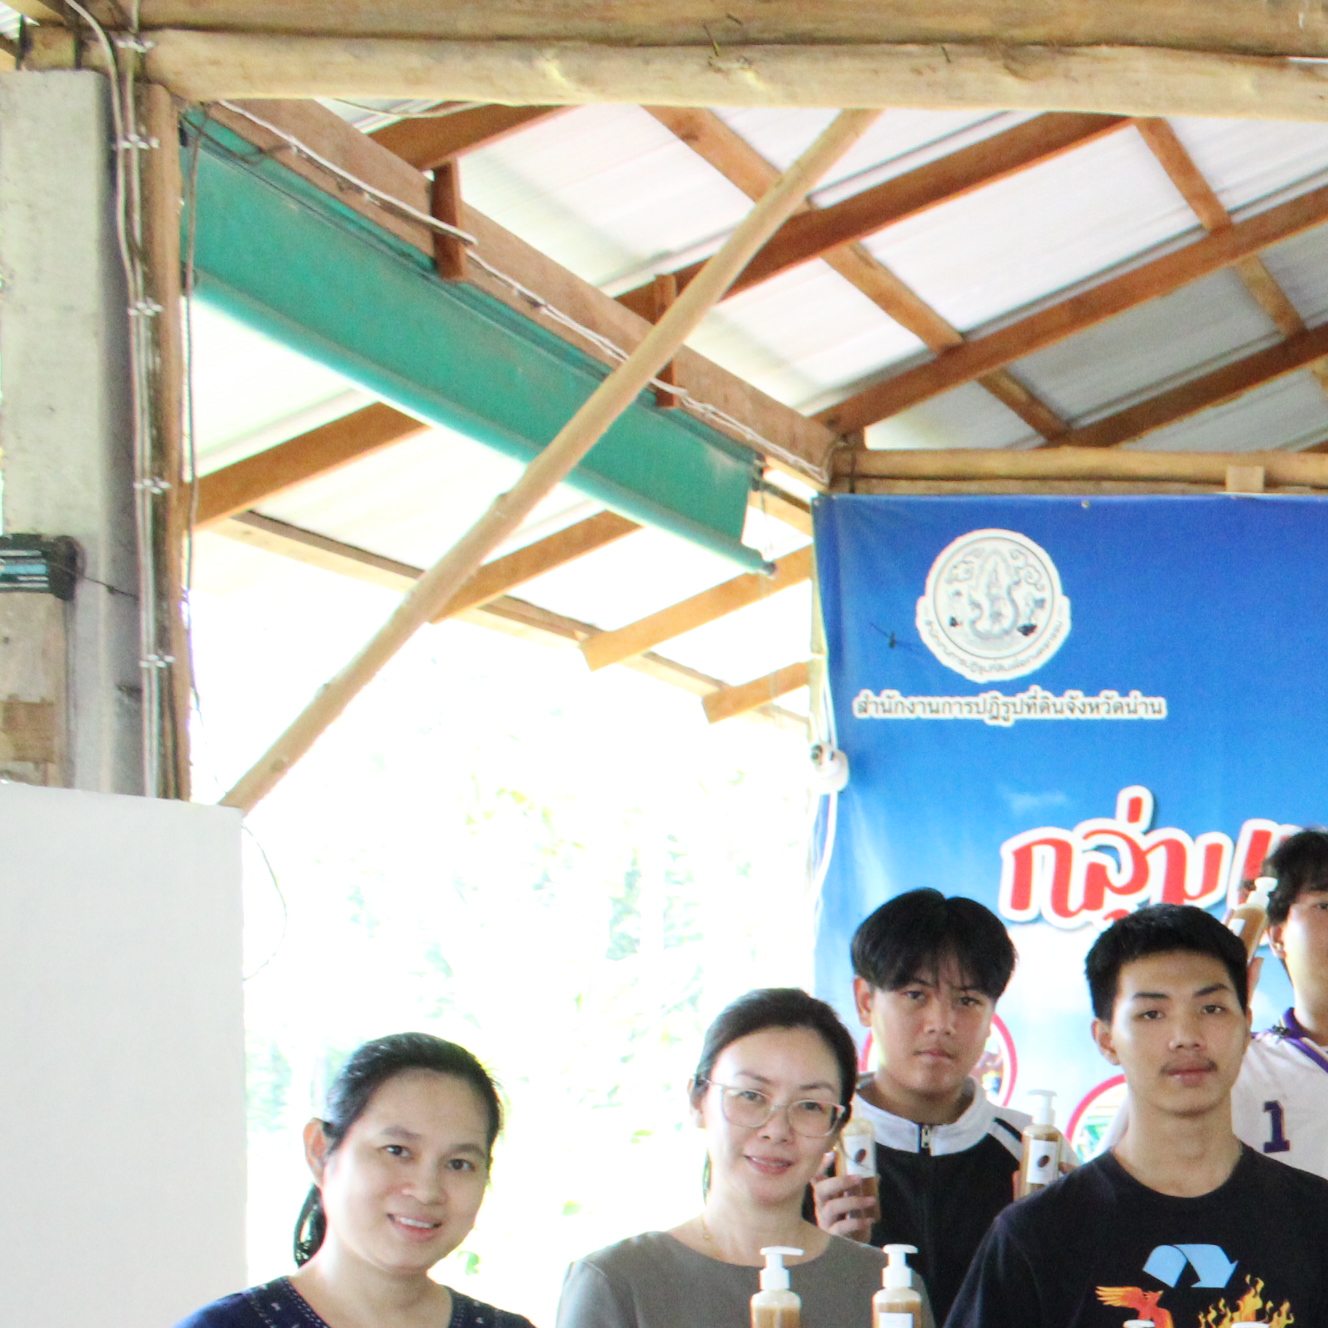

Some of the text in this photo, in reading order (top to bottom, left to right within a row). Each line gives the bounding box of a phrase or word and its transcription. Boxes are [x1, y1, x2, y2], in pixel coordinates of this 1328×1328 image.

[856, 686, 1164, 722] สำนักงานการปฏิรูปที่ดินจังหวัดน่าน
[1263, 1100, 1290, 1153] 1
